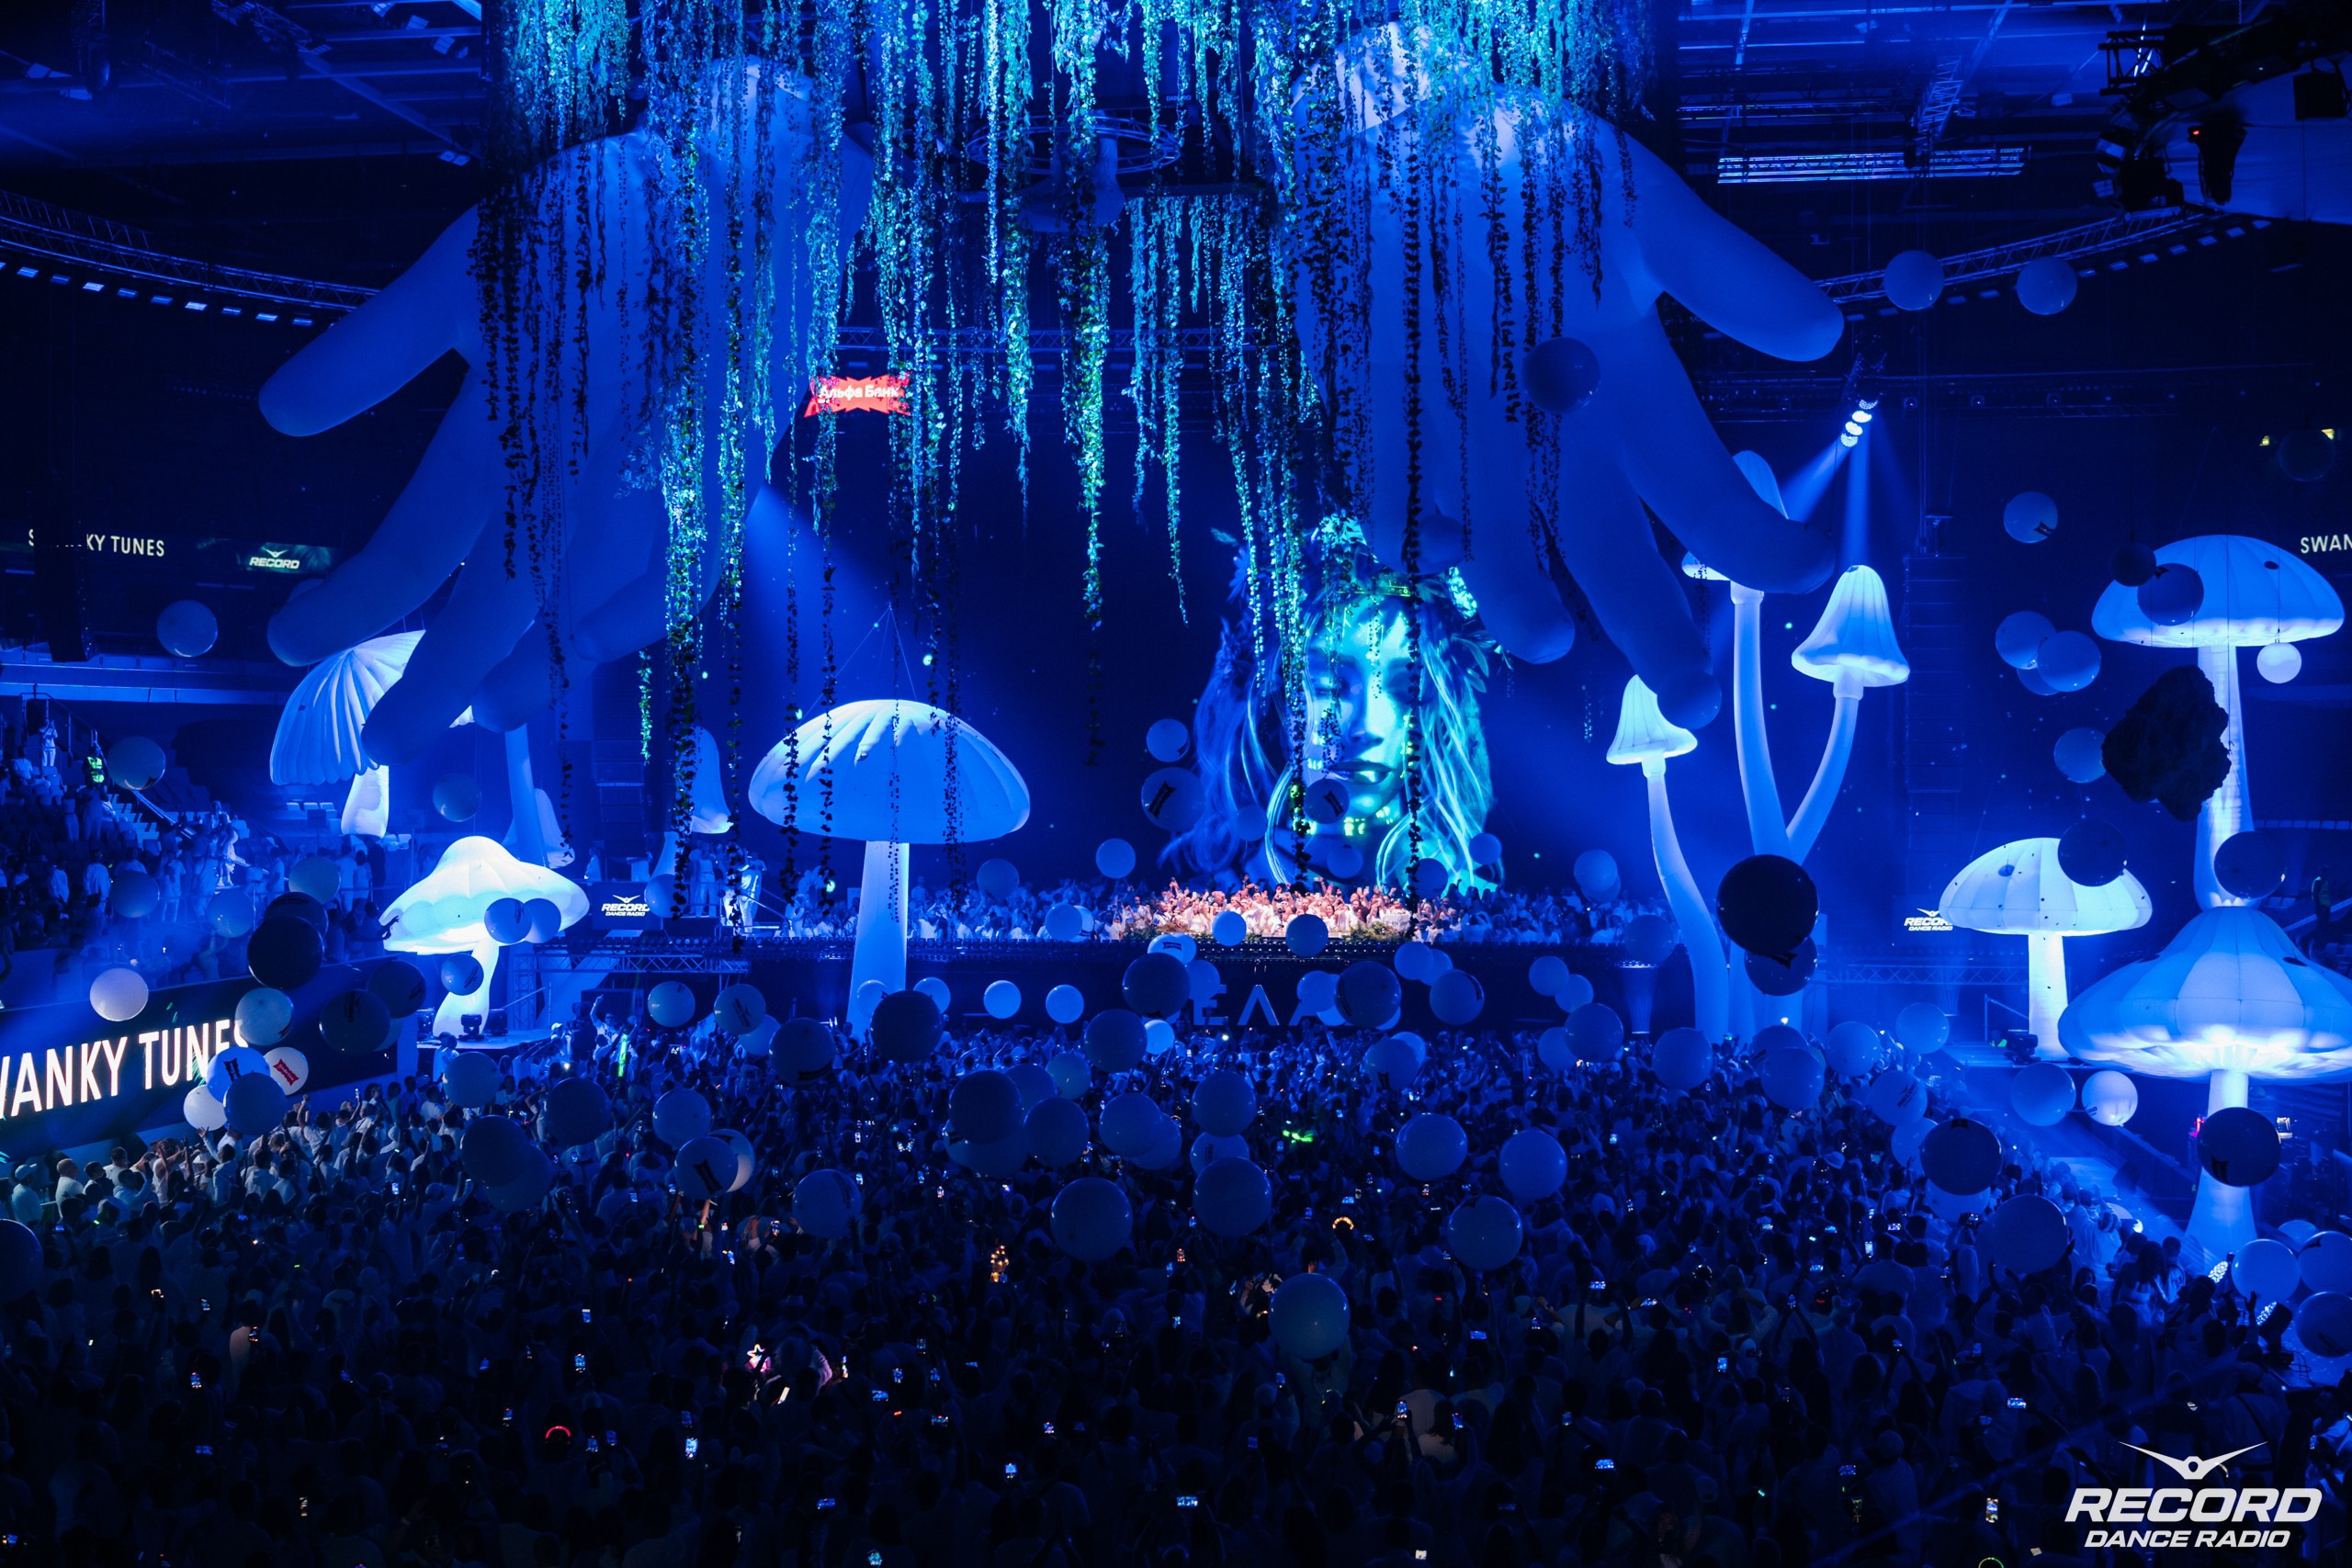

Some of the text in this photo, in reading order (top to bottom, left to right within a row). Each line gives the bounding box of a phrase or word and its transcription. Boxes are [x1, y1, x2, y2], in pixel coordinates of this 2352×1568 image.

[818, 384, 899, 401] Альфа Банк
[110, 536, 164, 557] TUNES
[249, 557, 300, 569] RECORD
[1904, 917, 1952, 926] RECOR
